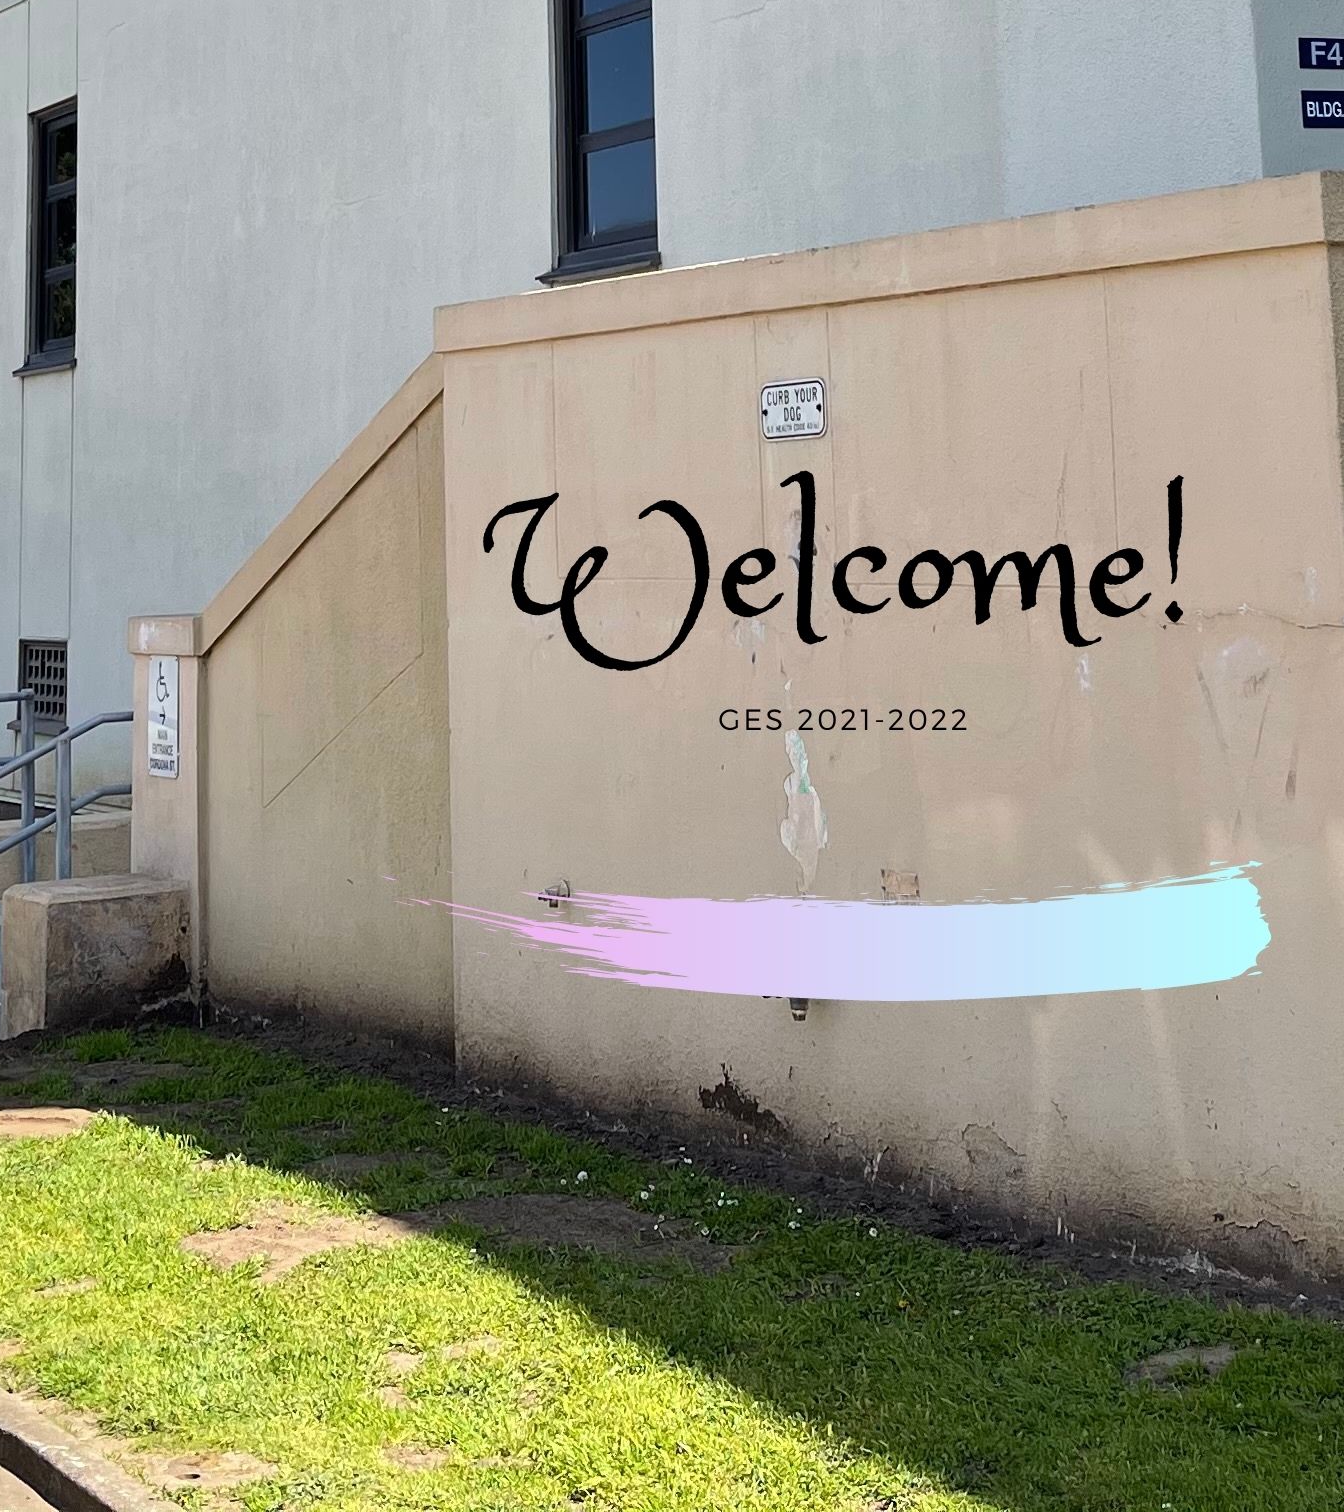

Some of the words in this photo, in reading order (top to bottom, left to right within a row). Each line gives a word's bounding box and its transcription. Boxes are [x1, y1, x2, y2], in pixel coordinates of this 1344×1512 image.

[1310, 41, 1344, 66] F4
[766, 389, 790, 406] CURB
[794, 386, 818, 403] YOUR
[783, 405, 802, 422] DOG
